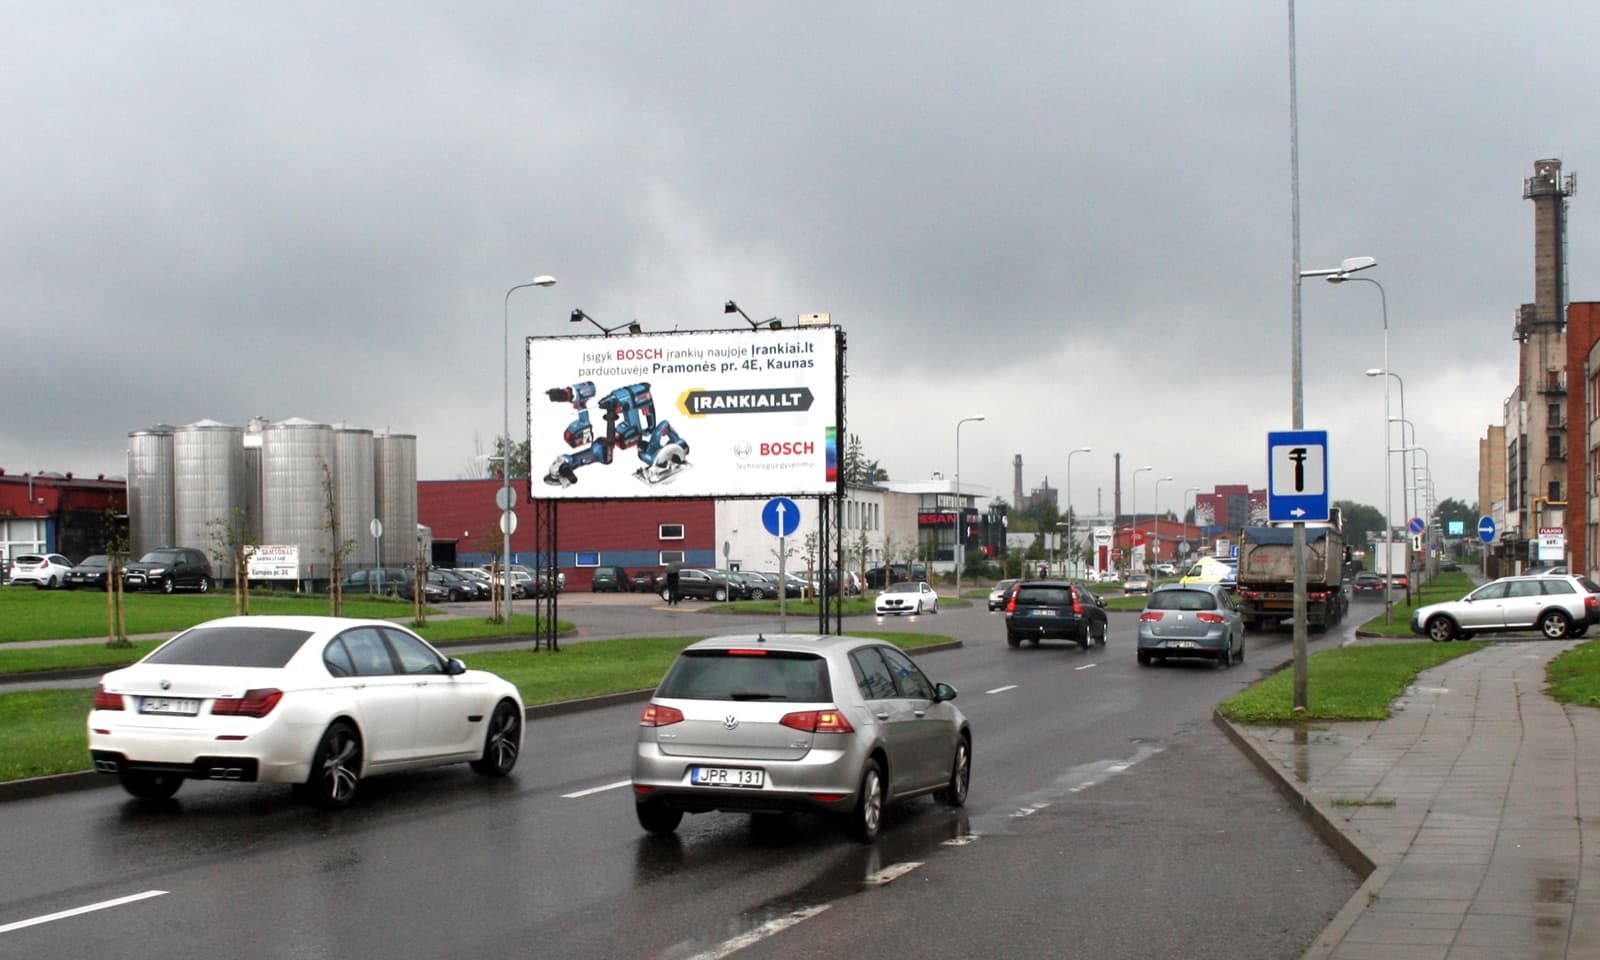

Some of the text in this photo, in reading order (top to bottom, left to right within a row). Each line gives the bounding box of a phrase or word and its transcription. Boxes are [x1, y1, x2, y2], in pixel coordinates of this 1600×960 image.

[582, 341, 814, 364] Įsigyk BOSCH įrankių naujoje Įrankiai.lt
[578, 357, 814, 378] parduotuvėje Pramonės pr. 4E, Kaunas
[693, 393, 802, 413] ĮRANKIAI.LT
[759, 441, 815, 456] BOSCH
[919, 514, 957, 524] SSAN
[700, 769, 760, 783] JPR 131
